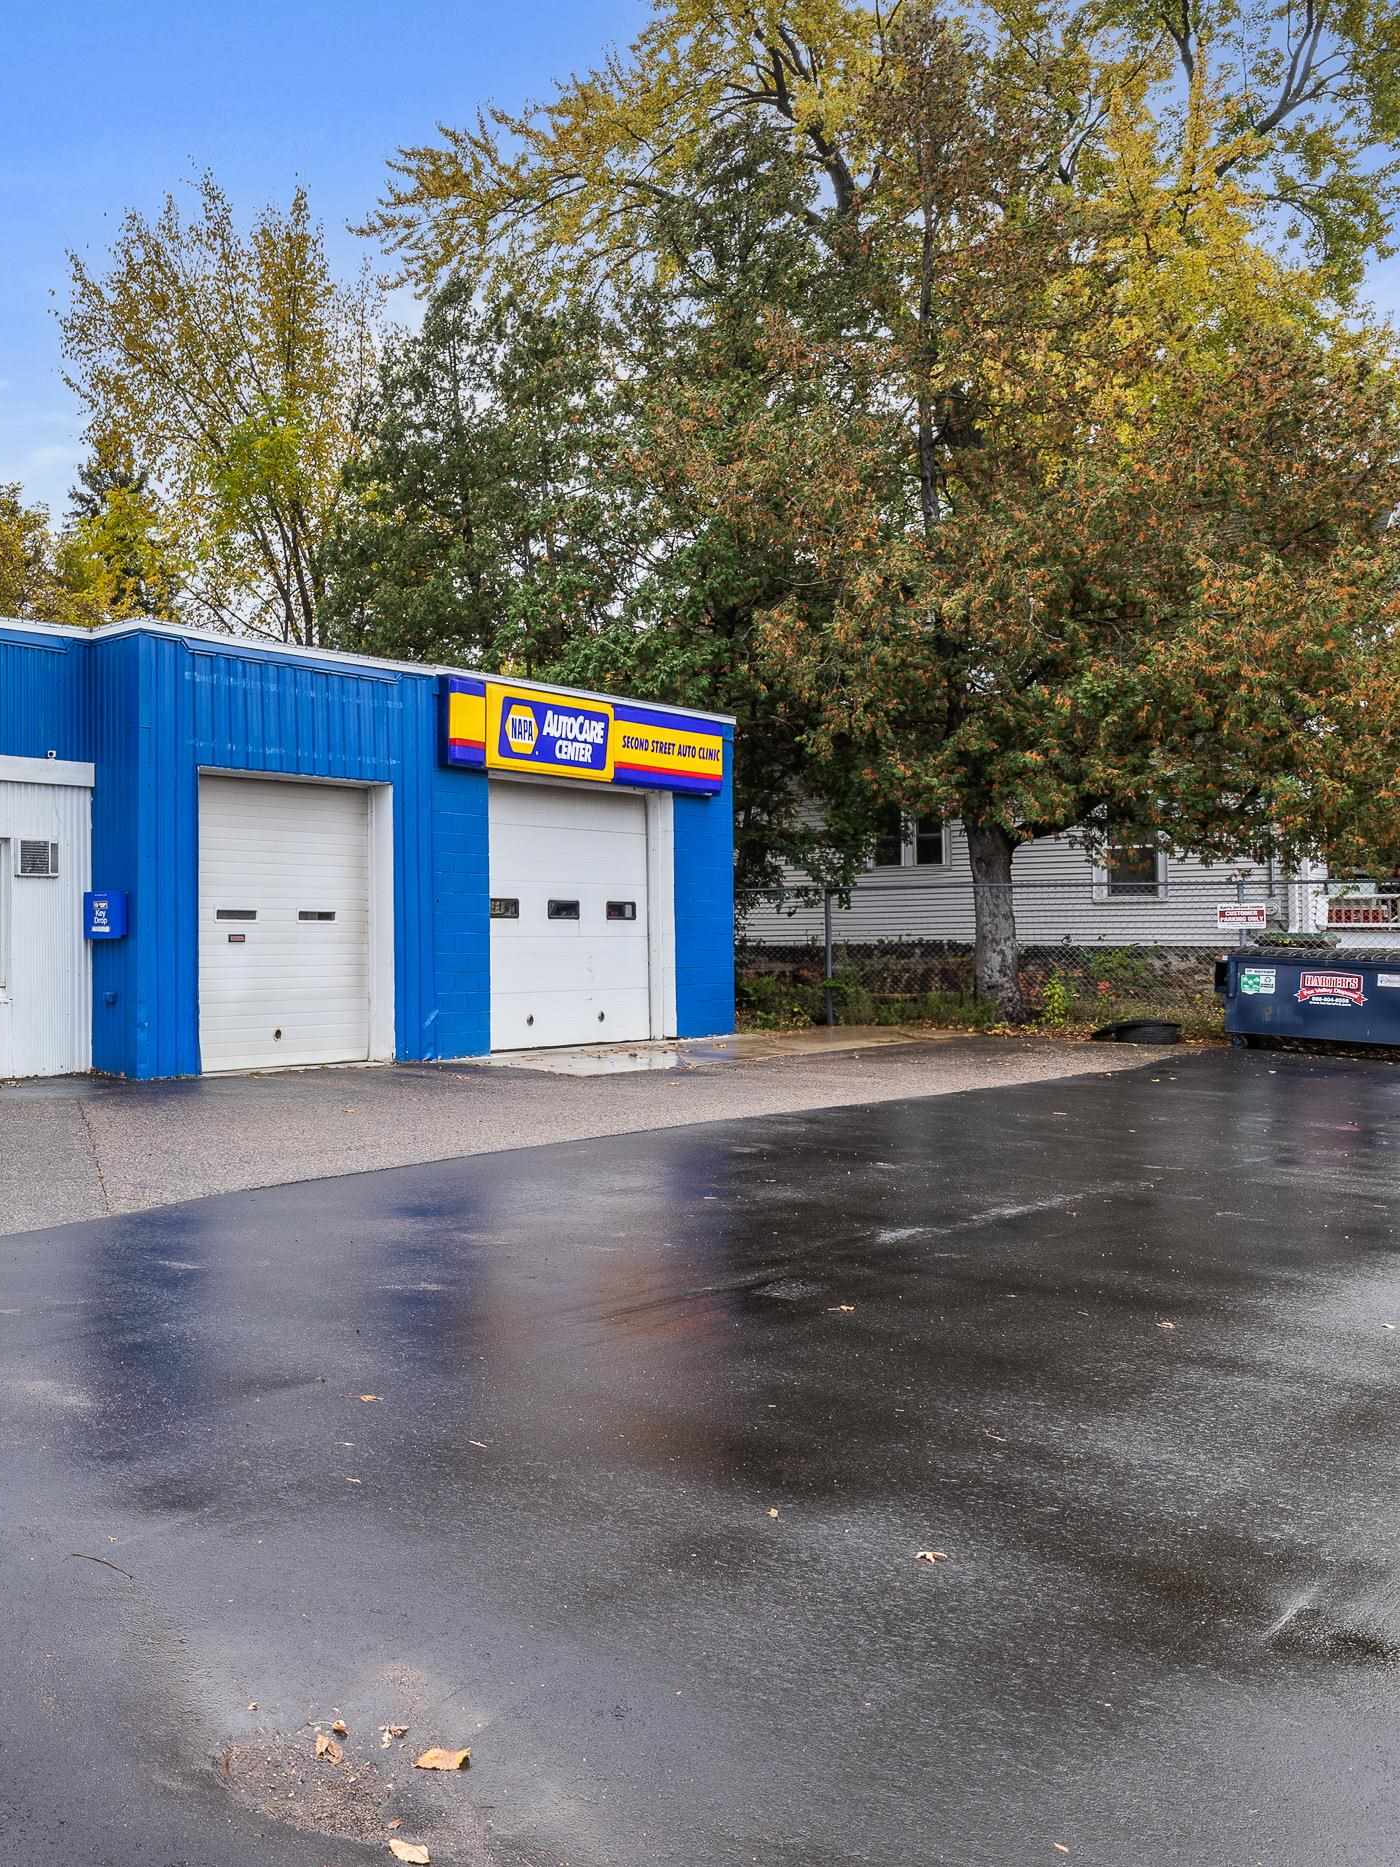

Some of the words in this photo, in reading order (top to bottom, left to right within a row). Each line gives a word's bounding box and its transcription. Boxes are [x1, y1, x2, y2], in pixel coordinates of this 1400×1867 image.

[511, 716, 534, 742] NAPA
[555, 742, 593, 763] CENTER
[622, 735, 649, 752] SECOND
[650, 739, 676, 756] STREET
[677, 744, 697, 758] AUTO
[698, 746, 721, 762] CLINIC
[96, 910, 106, 918] Key
